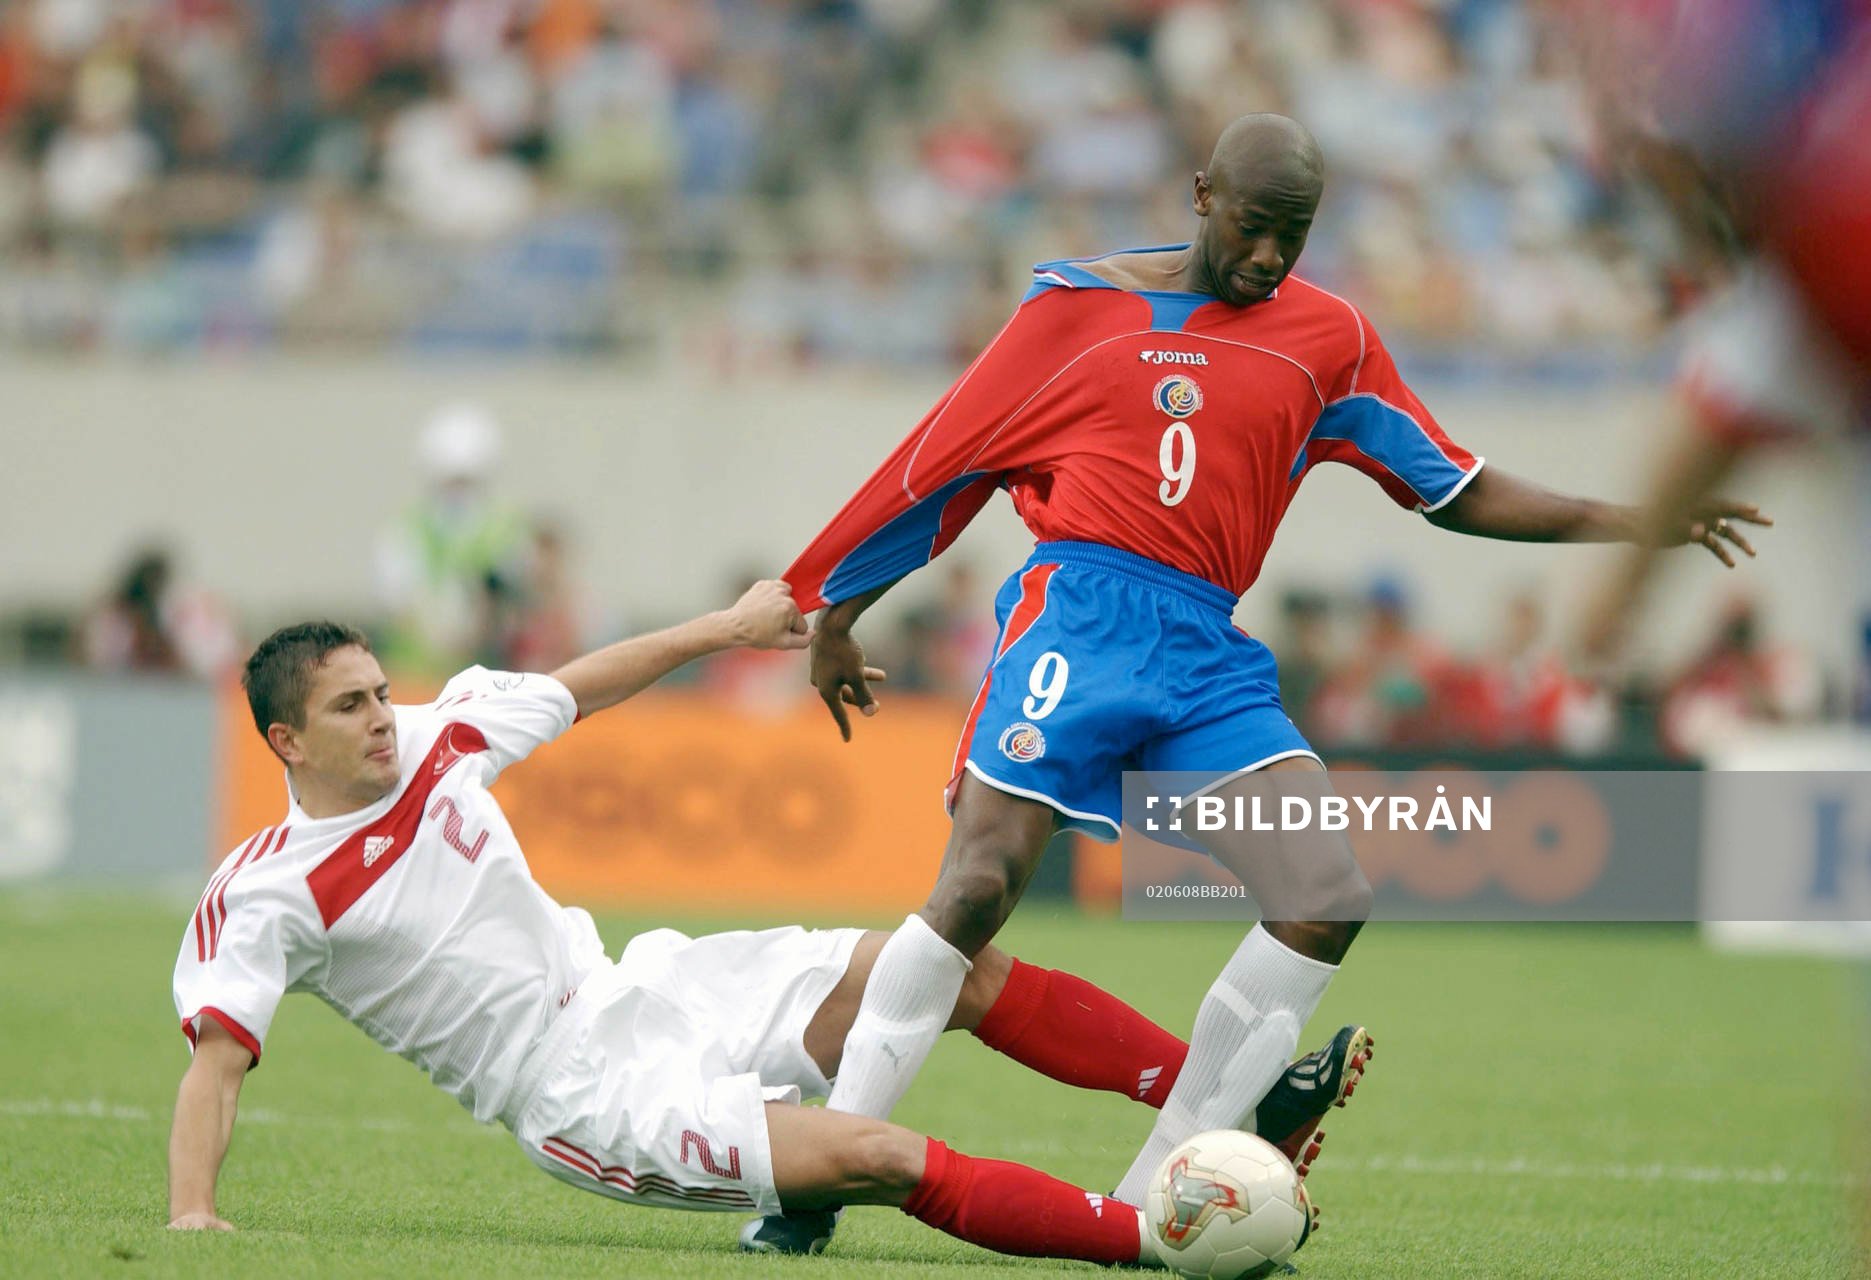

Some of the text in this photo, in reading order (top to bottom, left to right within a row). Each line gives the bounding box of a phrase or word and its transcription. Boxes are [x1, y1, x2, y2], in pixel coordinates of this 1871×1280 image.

[1153, 350, 1209, 366] Joma
[1159, 421, 1196, 507] 9
[1022, 651, 1069, 720] 9
[428, 796, 490, 864] 2
[680, 1129, 742, 1181] 2
